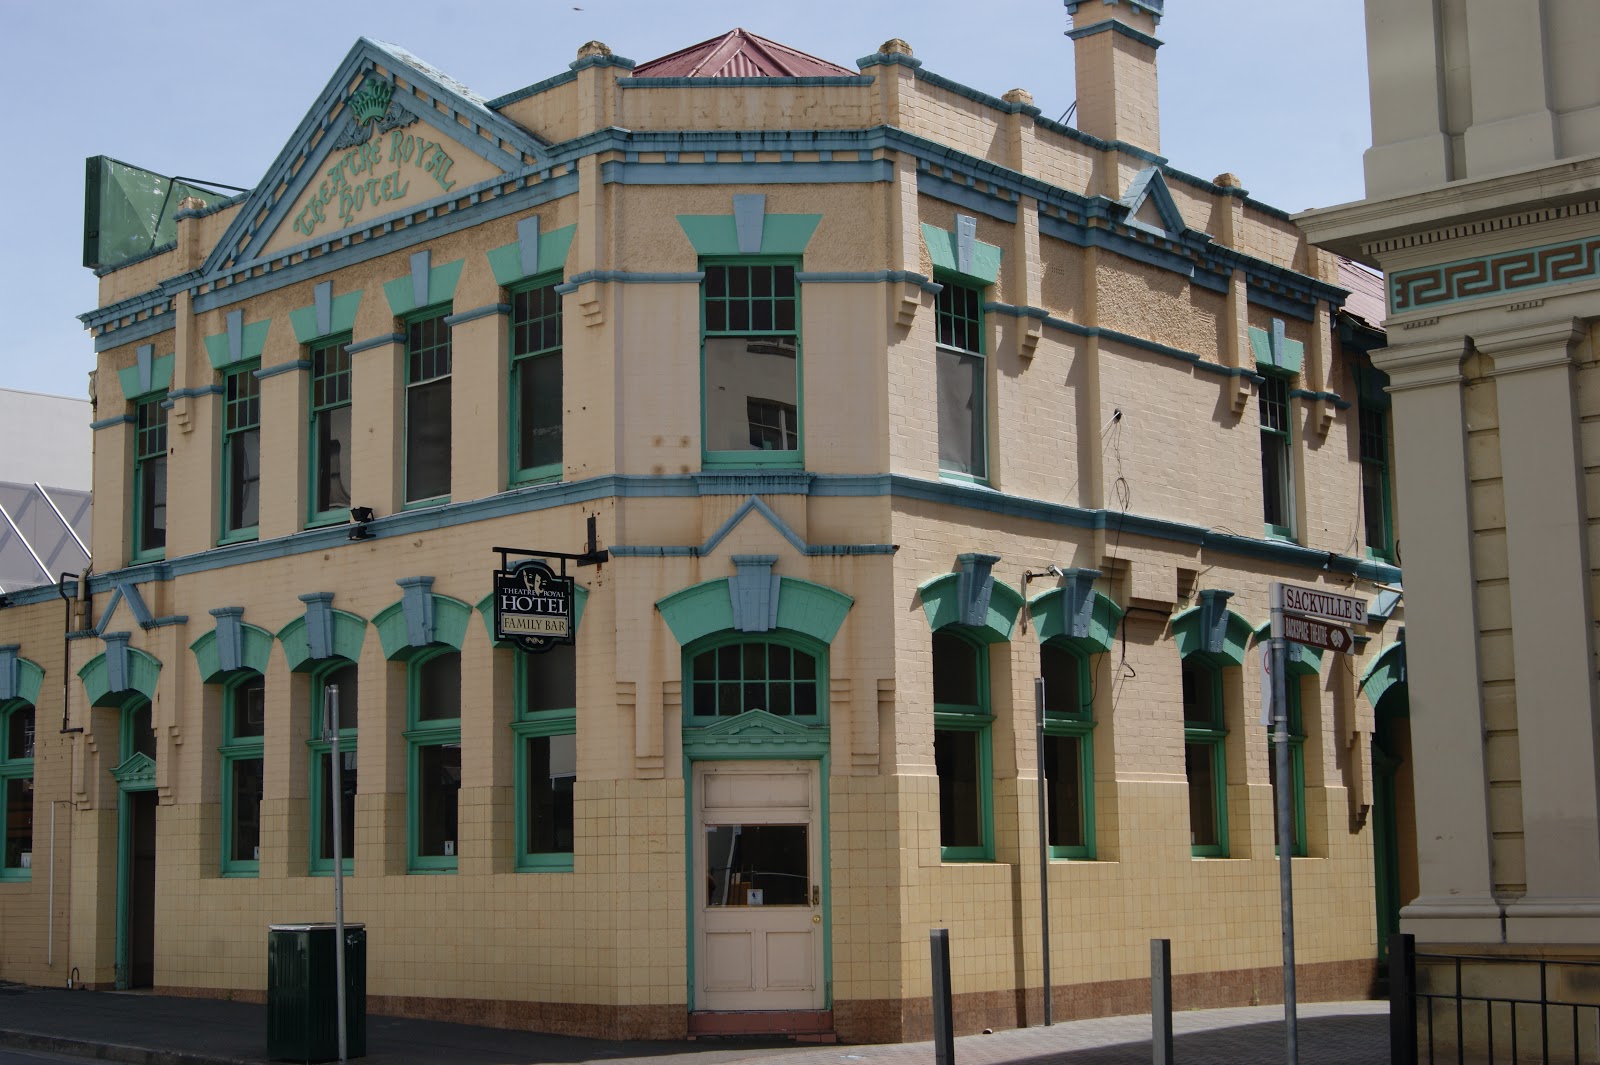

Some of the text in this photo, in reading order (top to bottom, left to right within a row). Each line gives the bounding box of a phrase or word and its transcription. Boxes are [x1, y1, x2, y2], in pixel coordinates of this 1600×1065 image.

[389, 130, 456, 192] ROYAL
[338, 170, 409, 228] HOTEL
[501, 594, 568, 615] HOTEL
[503, 587, 566, 598] THEATRE ROYAL
[1286, 588, 1352, 619] SACKVILLE
[504, 617, 566, 631] FAMILY BAR
[1285, 617, 1328, 646] BACKSPACE THEATRE
